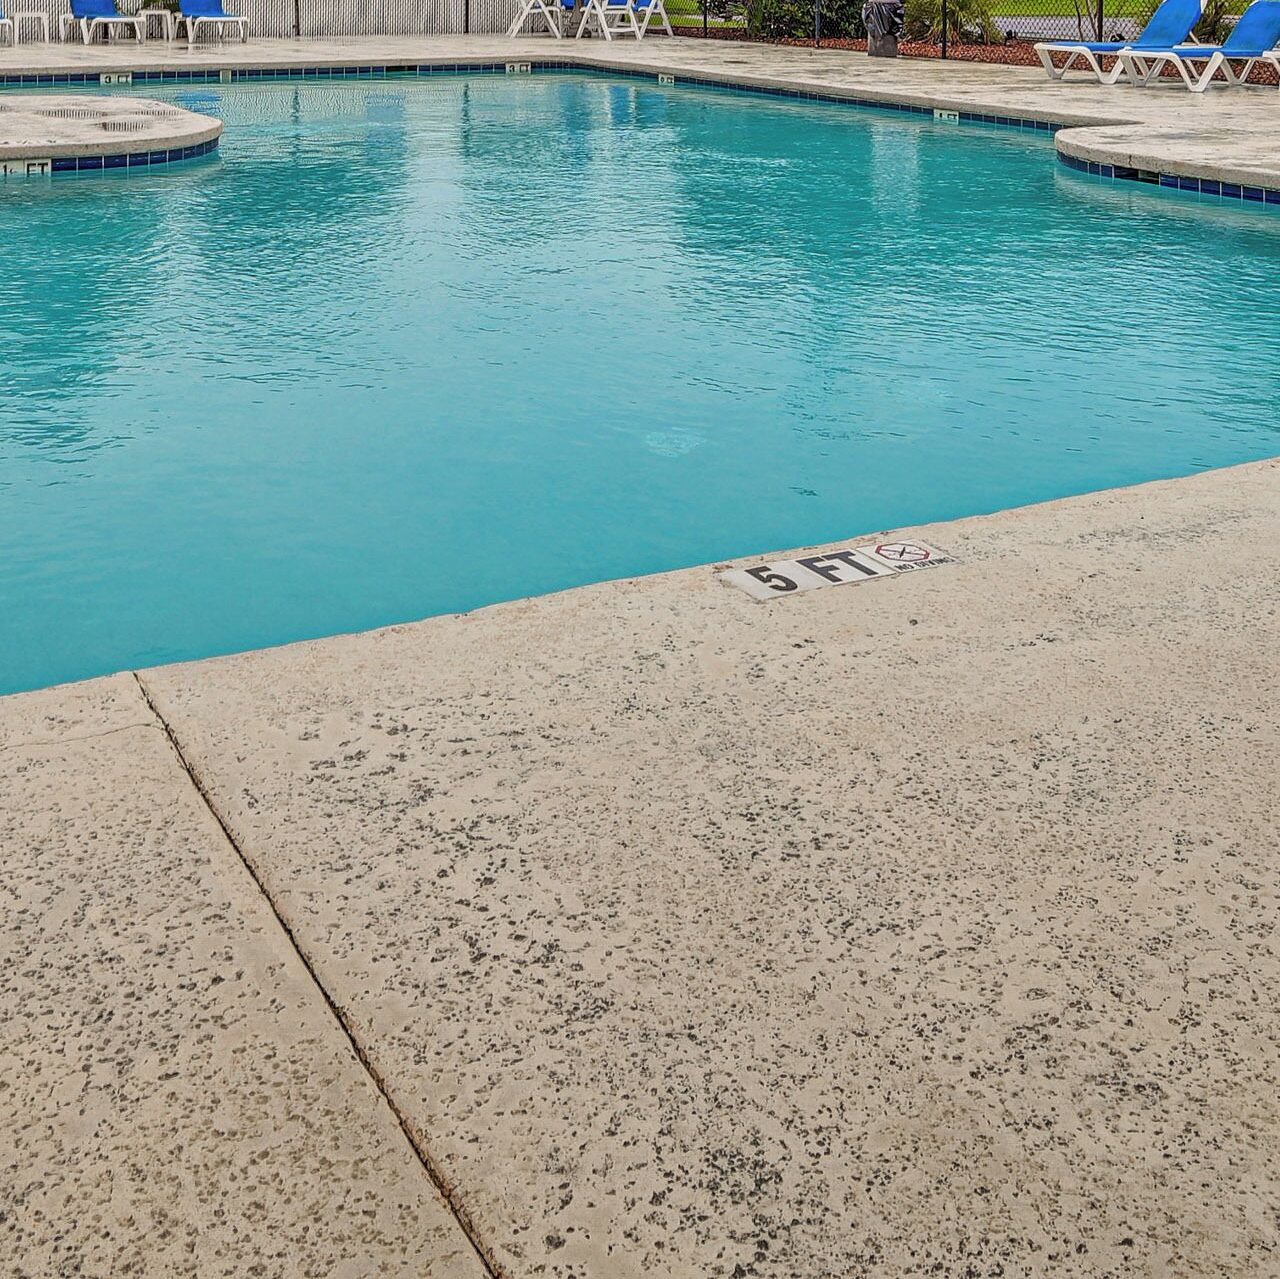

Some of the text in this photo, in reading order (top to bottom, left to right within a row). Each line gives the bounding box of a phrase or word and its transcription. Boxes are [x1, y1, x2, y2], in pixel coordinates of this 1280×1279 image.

[26, 162, 49, 177] FT
[743, 550, 879, 592] 5 FT
[894, 556, 957, 571] NO DIVING
